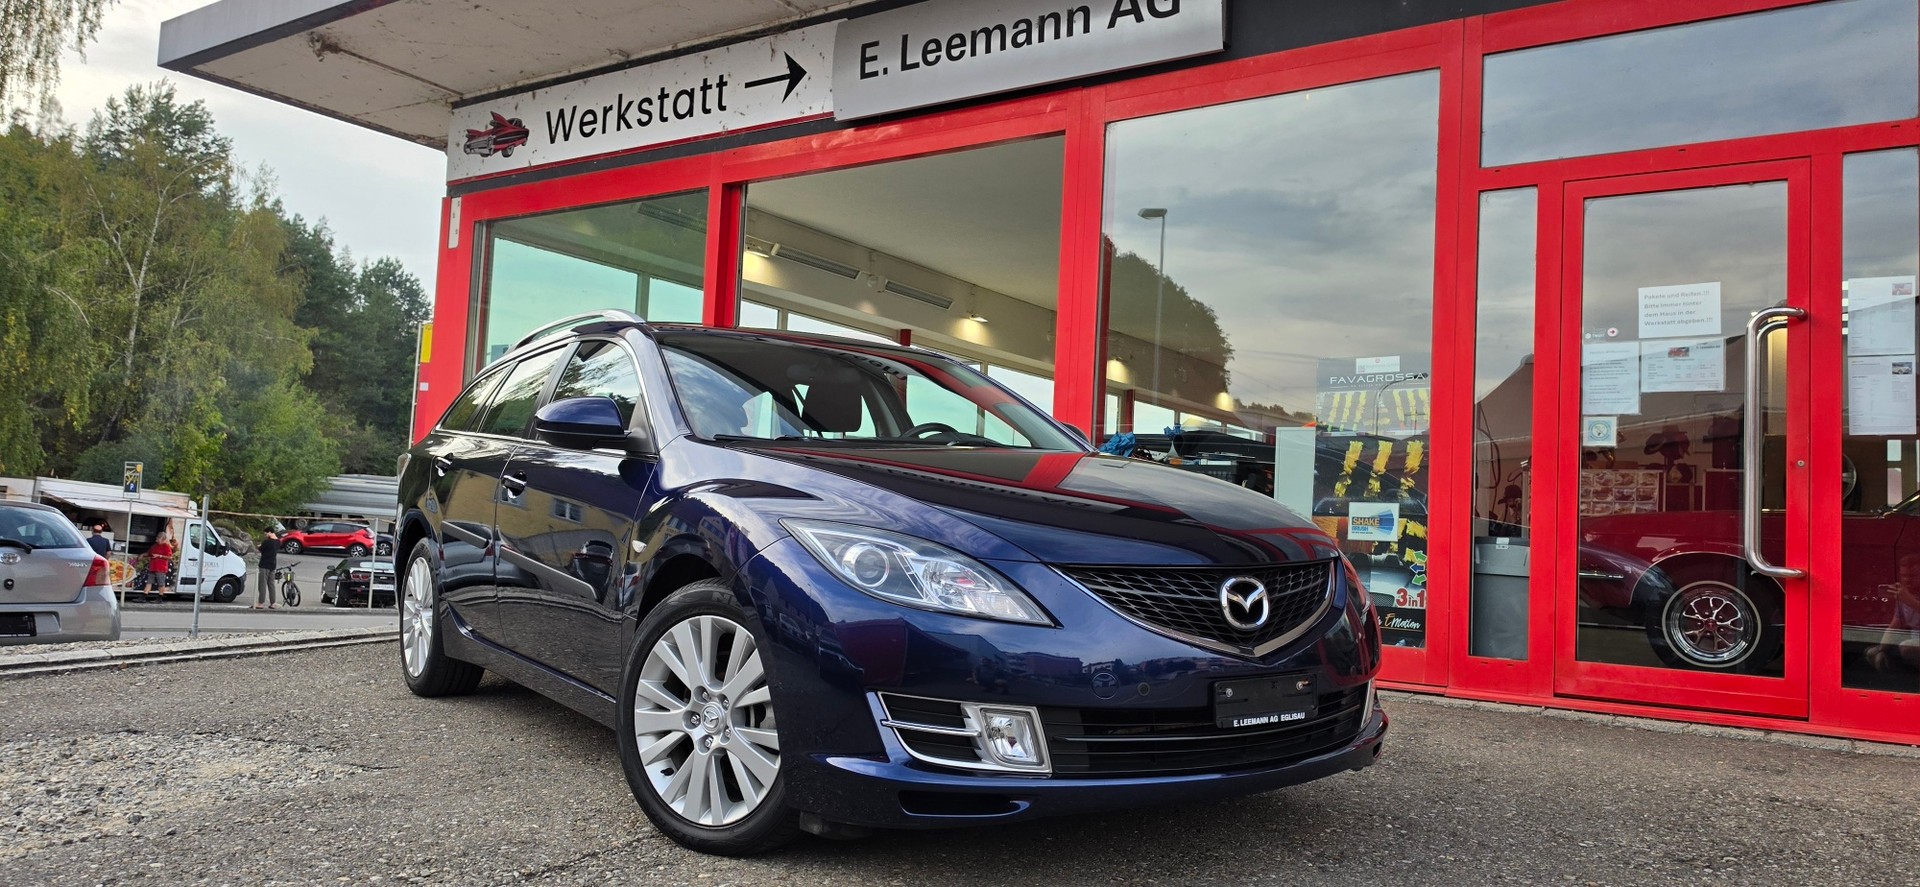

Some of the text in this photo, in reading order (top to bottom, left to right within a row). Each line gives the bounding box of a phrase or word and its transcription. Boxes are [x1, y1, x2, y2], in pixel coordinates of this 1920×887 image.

[860, 40, 888, 80] E.
[900, 5, 1091, 71] Leemann
[546, 74, 728, 144] Werkstatt
[1330, 373, 1426, 384] FAVAGROSSA
[1353, 517, 1380, 525] SHAKE
[1240, 717, 1268, 726] LEEMANN
[1269, 715, 1278, 723] AG
[1281, 712, 1305, 721] EGLISAU
